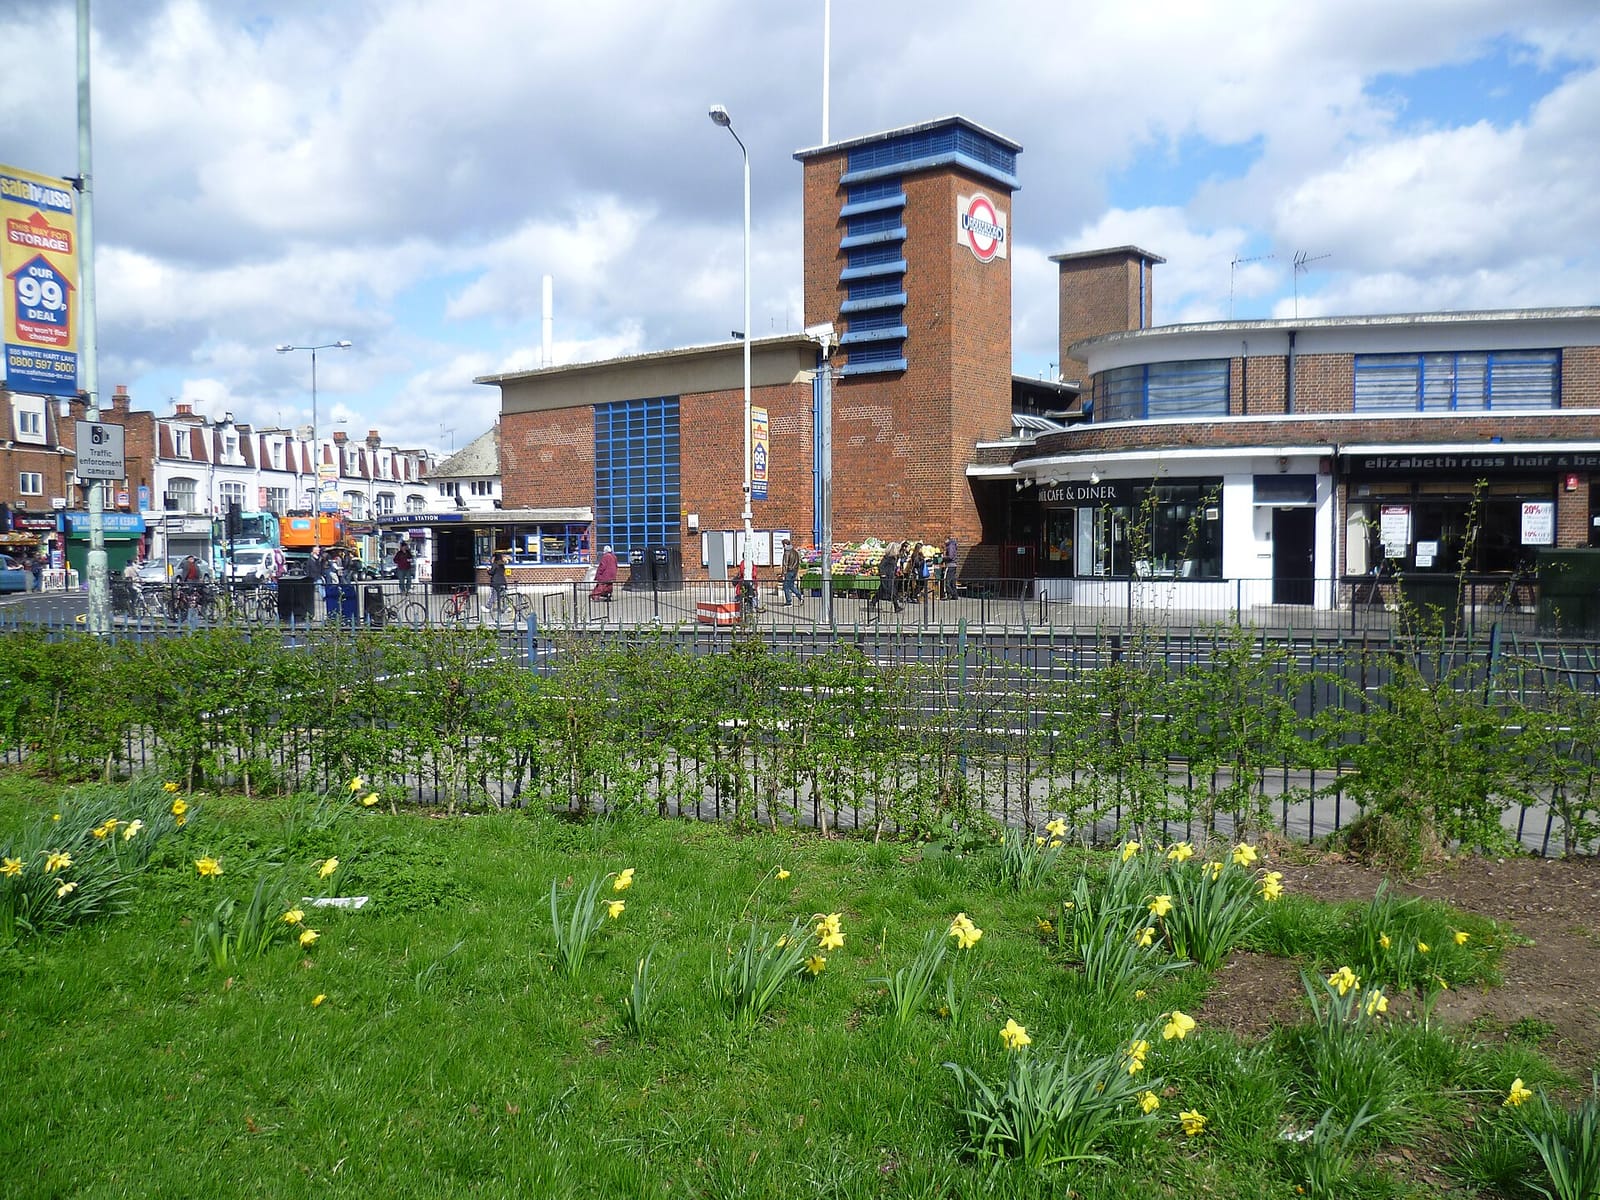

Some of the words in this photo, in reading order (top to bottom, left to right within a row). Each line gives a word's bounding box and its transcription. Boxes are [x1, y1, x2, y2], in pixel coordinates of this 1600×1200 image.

[10, 230, 69, 252] STORAGE!
[50, 231, 68, 241] FOR
[28, 266, 54, 280] OUR
[28, 309, 57, 322] DEAL
[22, 350, 42, 358] WHITE
[43, 353, 60, 361] HART
[10, 356, 34, 368] 0800
[35, 359, 52, 370] 597
[54, 361, 75, 374] 5000
[90, 448, 112, 458] Traffic
[80, 457, 122, 468] enforcement
[1364, 457, 1457, 469] elizabeth
[1461, 457, 1505, 468] ross
[1513, 455, 1552, 467] hair
[1557, 458, 1568, 466] &
[1047, 488, 1065, 501] CAFE
[1066, 486, 1075, 500] &
[1077, 486, 1117, 500] DINER
[1523, 505, 1541, 515] 20%
